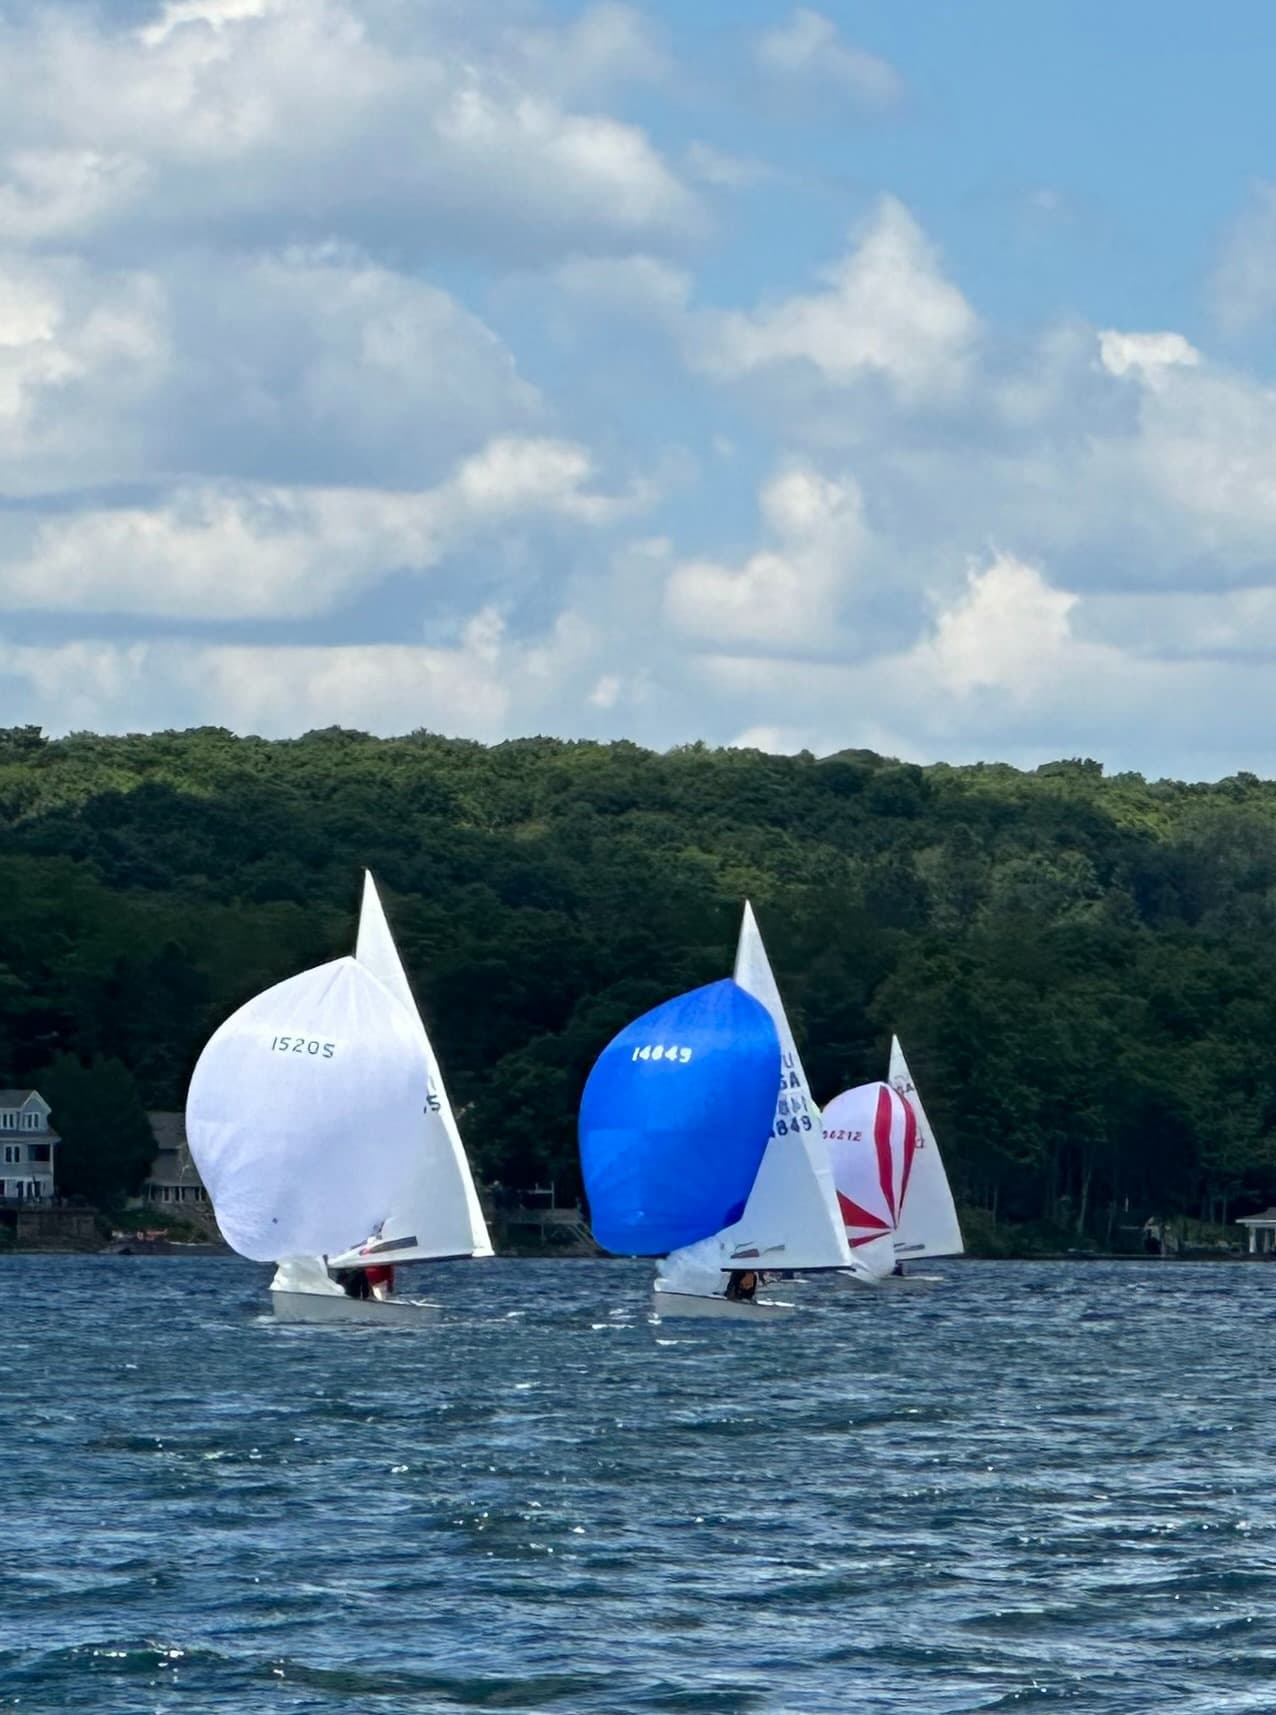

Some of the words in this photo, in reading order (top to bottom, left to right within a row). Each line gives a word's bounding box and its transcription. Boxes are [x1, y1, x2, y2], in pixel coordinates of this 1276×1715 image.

[272, 1036, 336, 1058] 15205
[632, 1044, 693, 1063] 14849
[773, 1115, 812, 1137] 849
